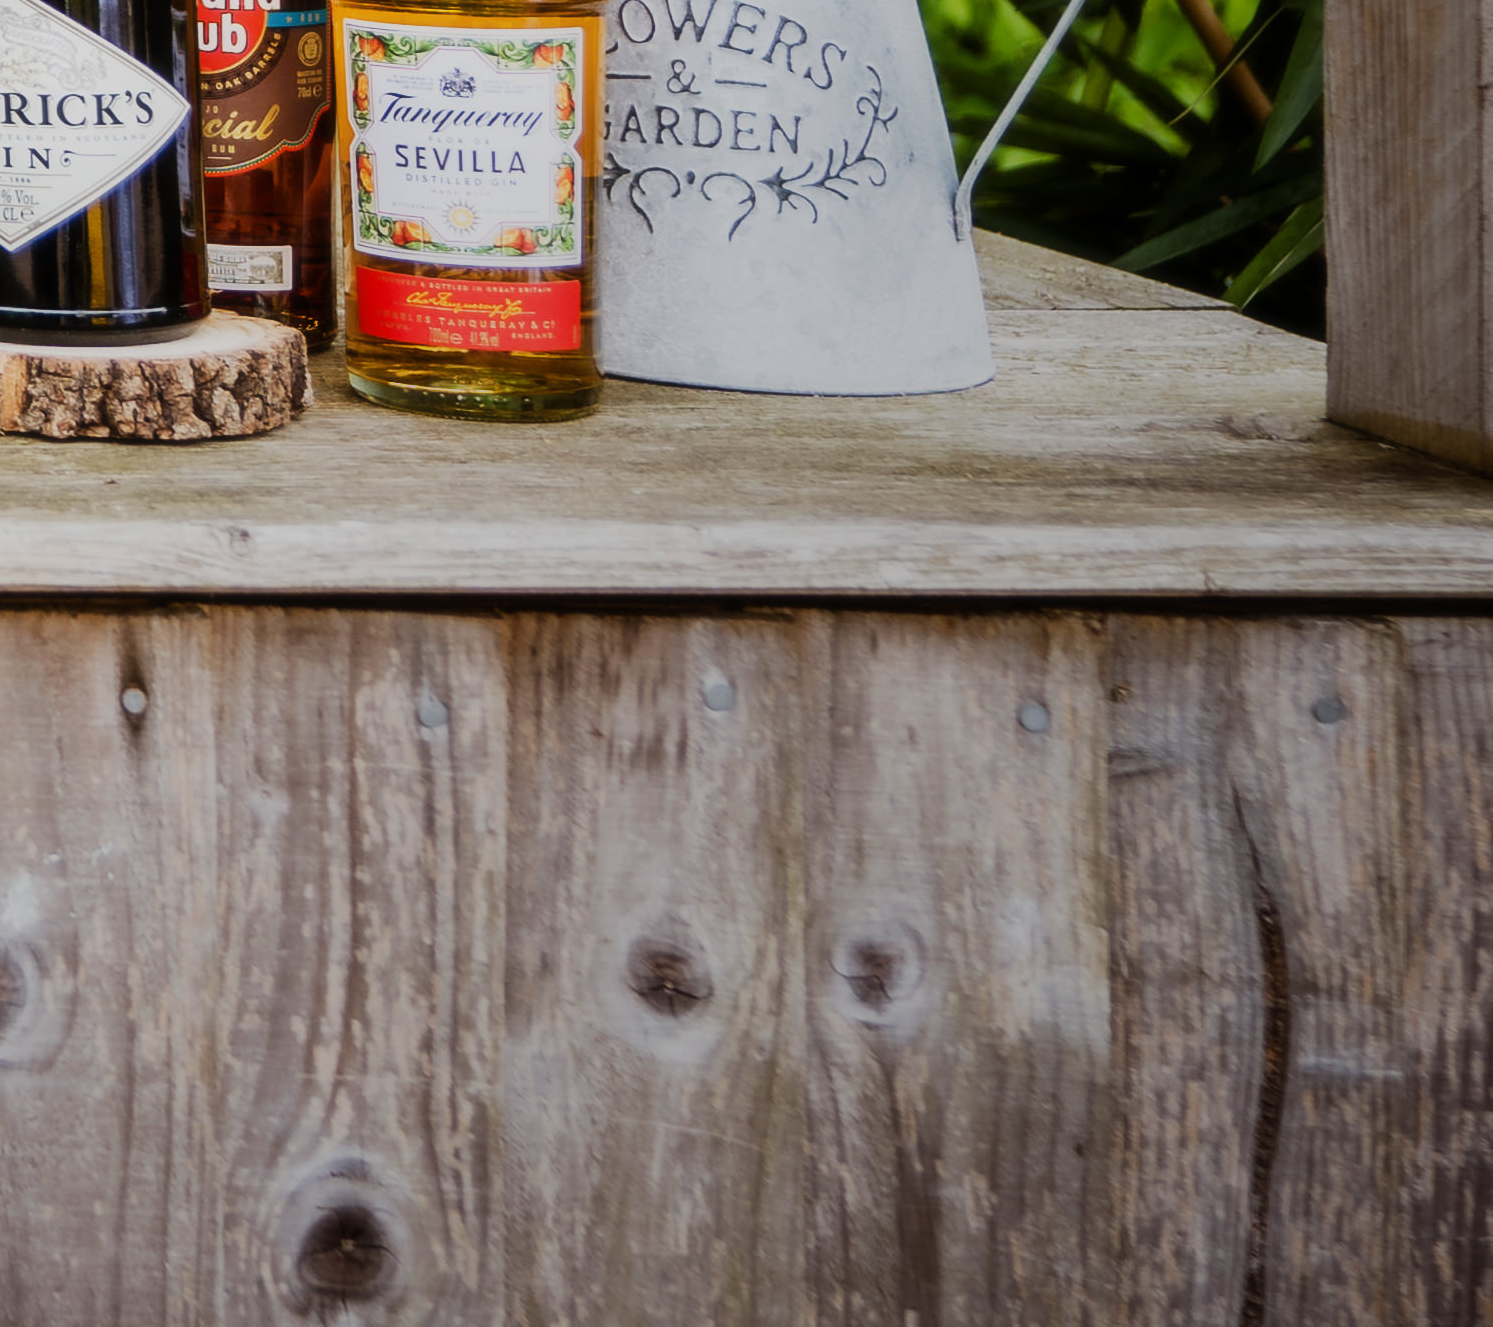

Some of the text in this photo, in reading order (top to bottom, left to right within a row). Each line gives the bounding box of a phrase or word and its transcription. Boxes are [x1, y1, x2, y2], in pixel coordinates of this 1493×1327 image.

[197, 12, 247, 54] ub
[216, 77, 242, 91] OAK
[244, 32, 282, 80] BARRELS
[666, 59, 702, 95] &
[202, 104, 281, 141] cial
[379, 92, 544, 137] Tanqueray
[395, 144, 526, 175] SEVILLA
[406, 173, 518, 187] DISTILLED GIN
[438, 316, 526, 330] TANQUERAY
